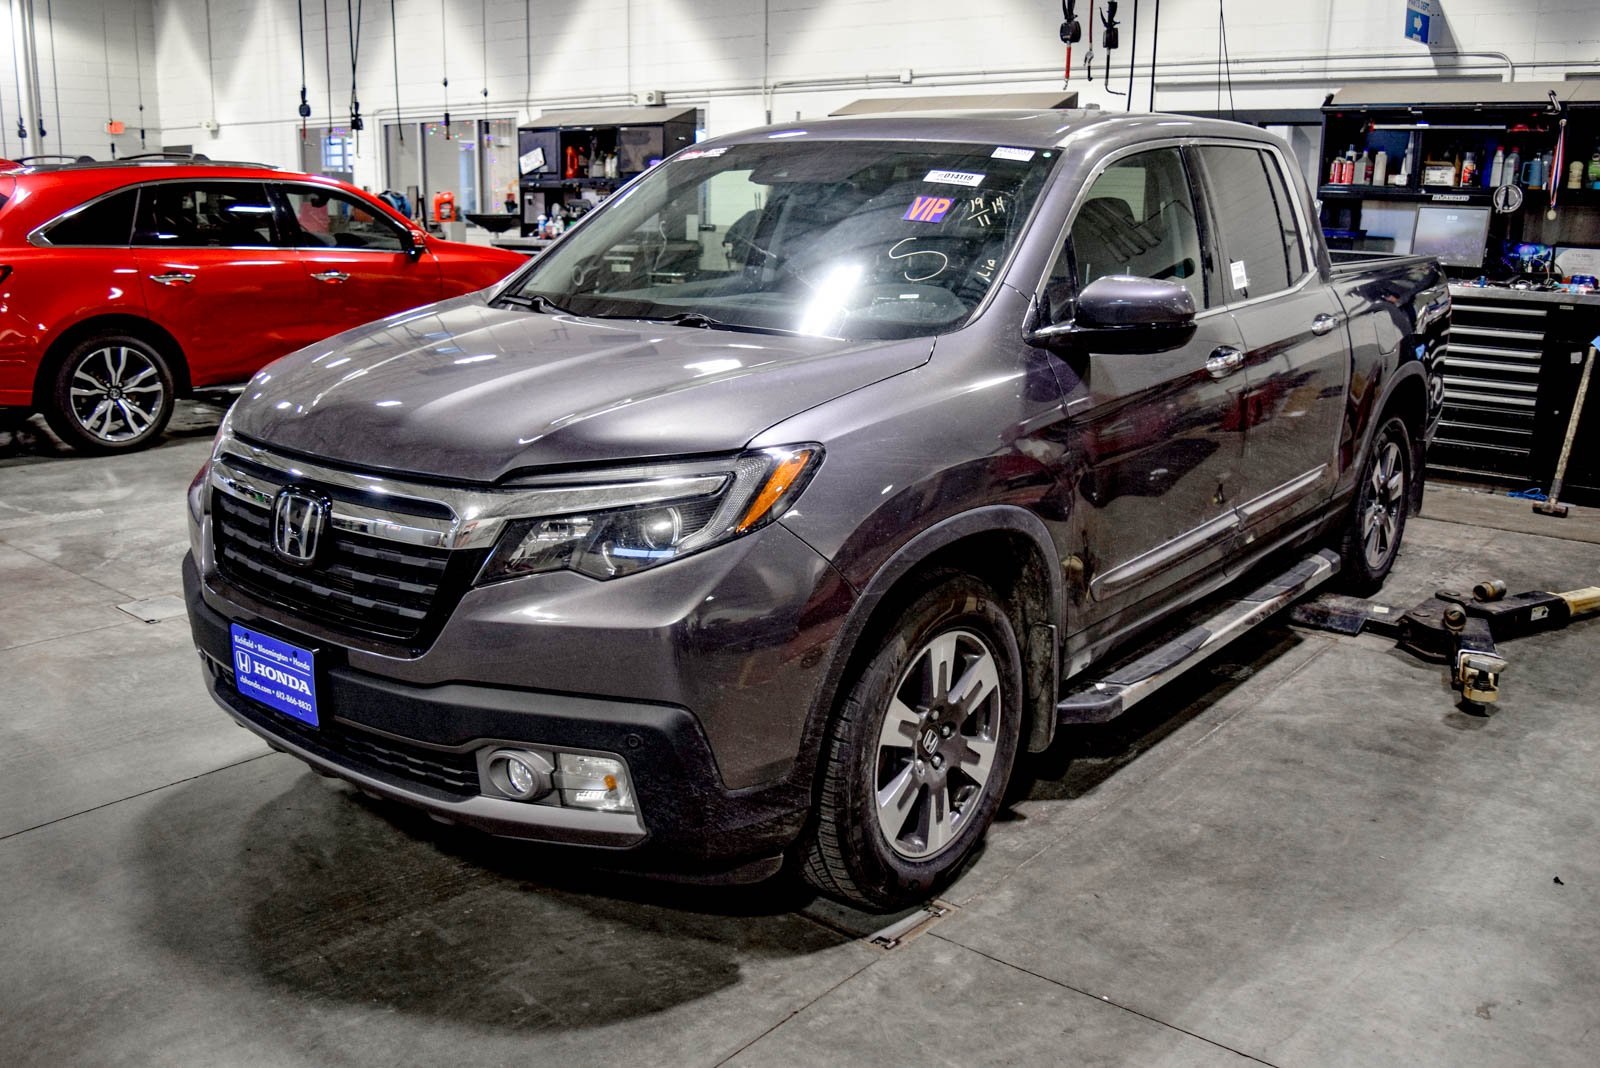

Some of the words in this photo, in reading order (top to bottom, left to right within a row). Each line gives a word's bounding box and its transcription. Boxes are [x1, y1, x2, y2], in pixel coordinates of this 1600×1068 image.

[908, 197, 950, 221] VIP
[234, 635, 254, 649] Richfield
[258, 644, 288, 662] Bloomington
[292, 657, 310, 671] Honda
[253, 660, 312, 696] HONDA
